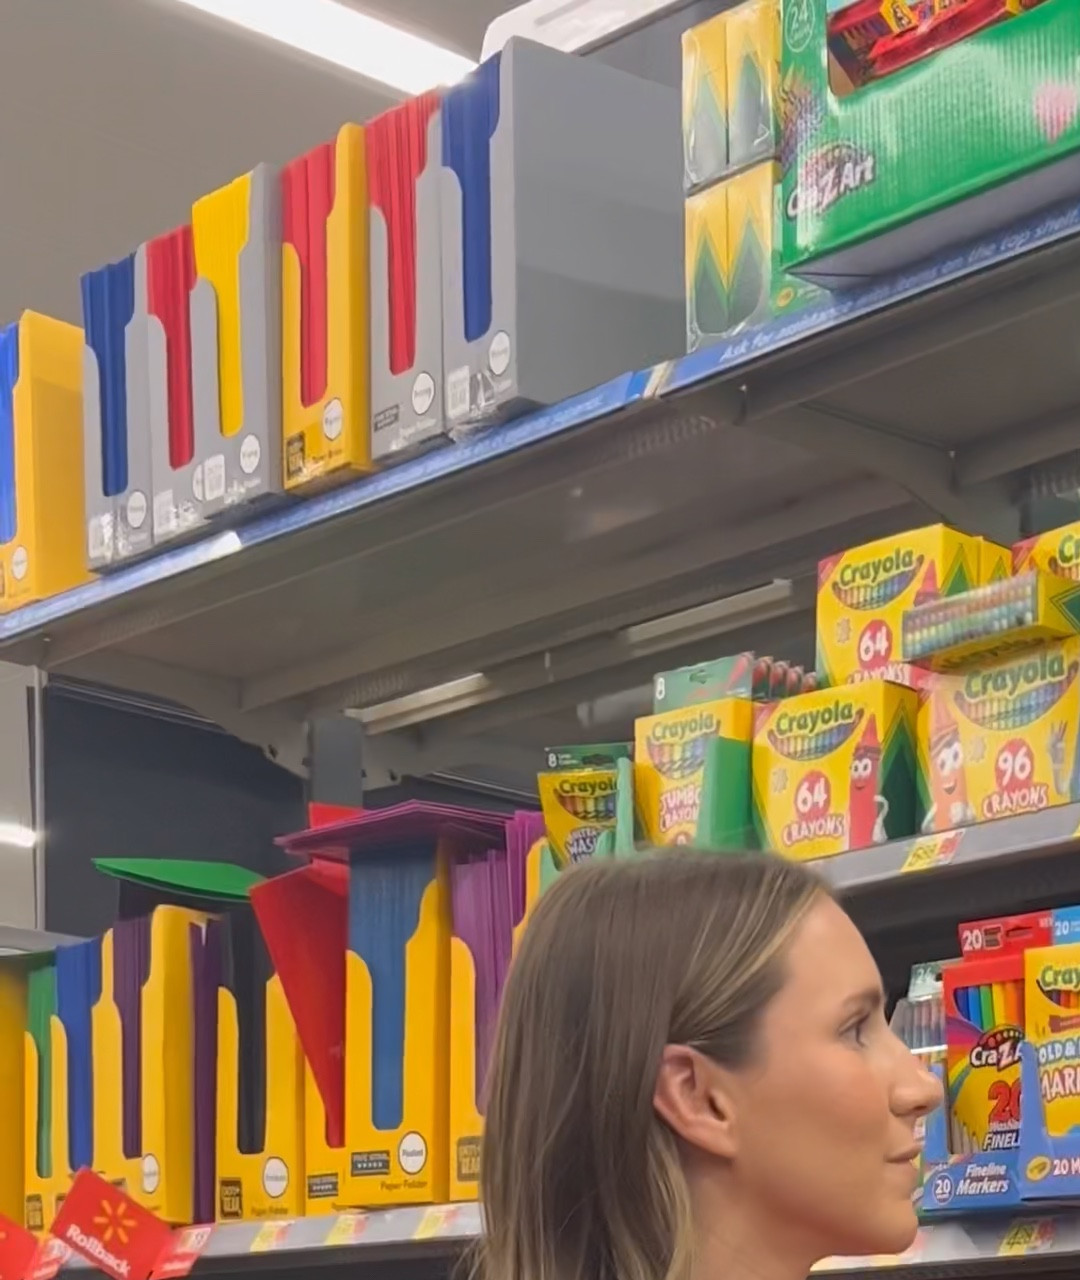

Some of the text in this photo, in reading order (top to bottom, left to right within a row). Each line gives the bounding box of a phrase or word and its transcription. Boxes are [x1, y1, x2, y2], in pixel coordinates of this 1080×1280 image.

[840, 547, 917, 588] Crayola
[860, 625, 890, 663] 64
[655, 677, 666, 700] 8
[963, 656, 1066, 701] Crayola
[651, 712, 715, 741] Crayola
[775, 701, 854, 738] Crayola
[549, 754, 558, 769] 8
[997, 745, 1031, 782] 96
[797, 778, 828, 814] 64
[982, 786, 1049, 816] CRAYONS
[963, 928, 983, 951] 20
[1055, 920, 1070, 935] 20
[970, 1040, 1023, 1072] Cra-Z-A
[987, 1080, 1022, 1121] 20
[983, 1131, 1021, 1150] FINEL
[965, 1162, 1007, 1179] Fineline
[1052, 1158, 1069, 1177] 20
[935, 1175, 1009, 1196] 20 Markers
[66, 1223, 131, 1278] Rollback
